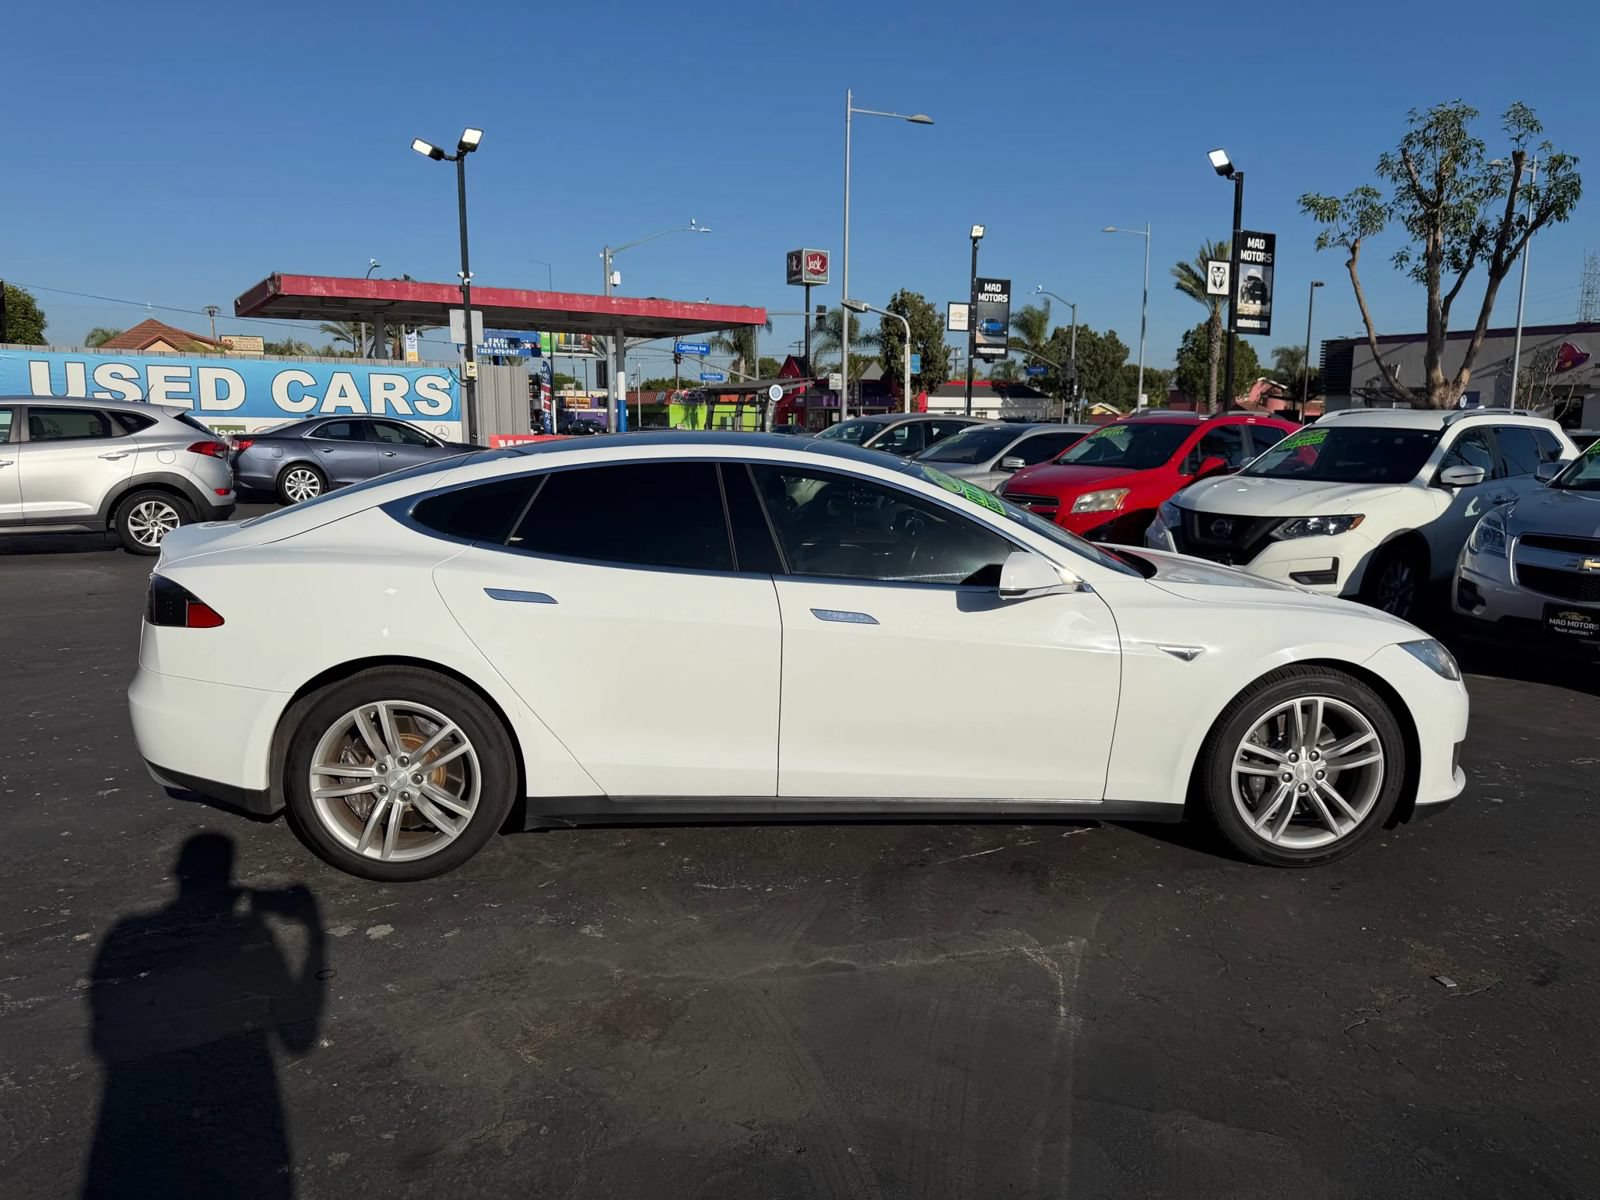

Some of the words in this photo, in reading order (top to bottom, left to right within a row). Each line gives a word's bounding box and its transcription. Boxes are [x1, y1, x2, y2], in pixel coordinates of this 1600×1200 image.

[1247, 237, 1265, 249] MAD
[1241, 250, 1272, 263] MOTORS
[807, 255, 826, 272] Jack
[984, 282, 1002, 292] MAD
[978, 292, 1008, 303] MOTORS
[678, 344, 698, 352] California
[29, 360, 247, 412] USED
[271, 368, 454, 417] CARS
[1548, 618, 1566, 626] MAD
[1567, 620, 1600, 631] MOTORS
